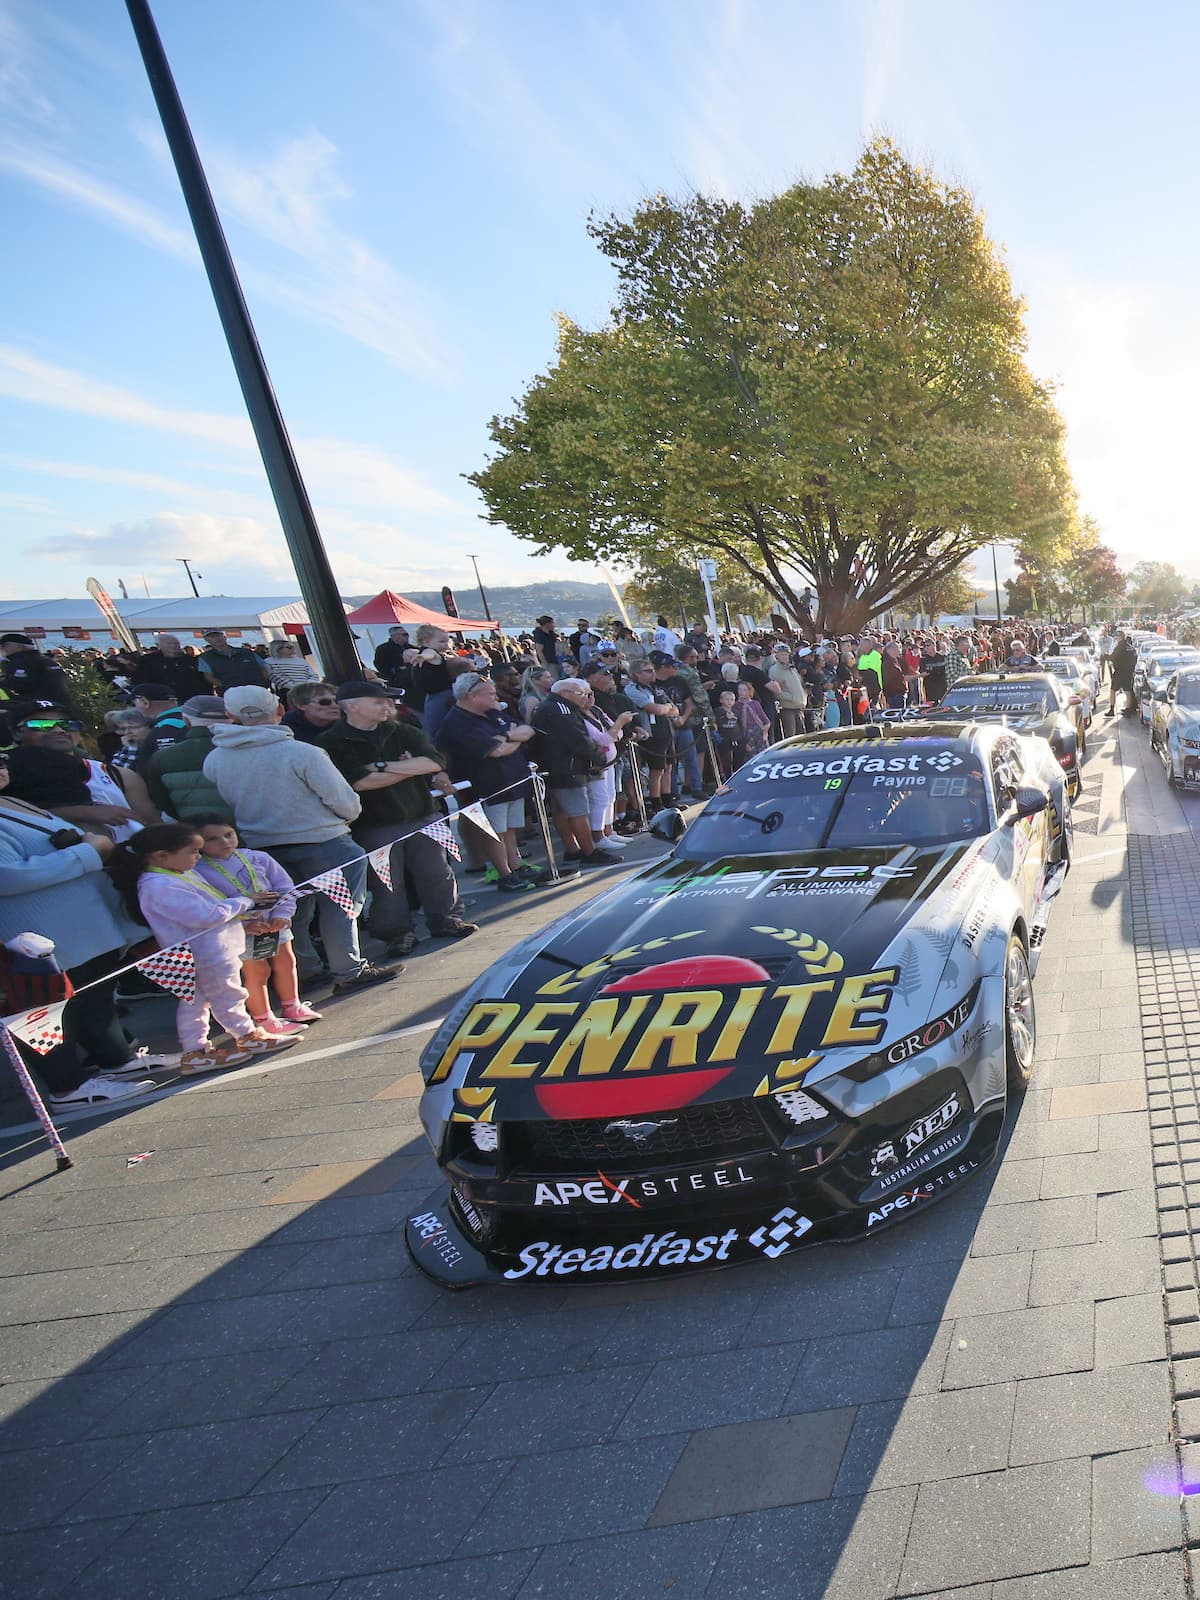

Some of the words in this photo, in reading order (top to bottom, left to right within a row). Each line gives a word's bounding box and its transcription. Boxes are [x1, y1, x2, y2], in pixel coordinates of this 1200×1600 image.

[993, 702, 1034, 712] HIRE
[746, 754, 922, 783] Steadfast
[823, 778, 843, 791] 19
[873, 775, 926, 788] Payne
[652, 865, 918, 899] alspec
[775, 880, 882, 891] ALUMINIUM
[780, 888, 877, 898] HARDWARE
[962, 909, 986, 949] DASHER
[431, 968, 900, 1084] PENRITE
[888, 999, 970, 1065] GROVE
[902, 1097, 961, 1152] NED
[880, 1152, 931, 1189] AUSTRALIAN
[932, 1133, 962, 1158] WHISKY
[534, 1173, 641, 1206] APEX
[641, 1167, 753, 1196] STEEL
[867, 1187, 929, 1228] APEX
[924, 1160, 979, 1192] STEEL
[410, 1211, 447, 1242] APEX
[432, 1232, 464, 1268] STEEL
[503, 1228, 740, 1280] Steadfast
